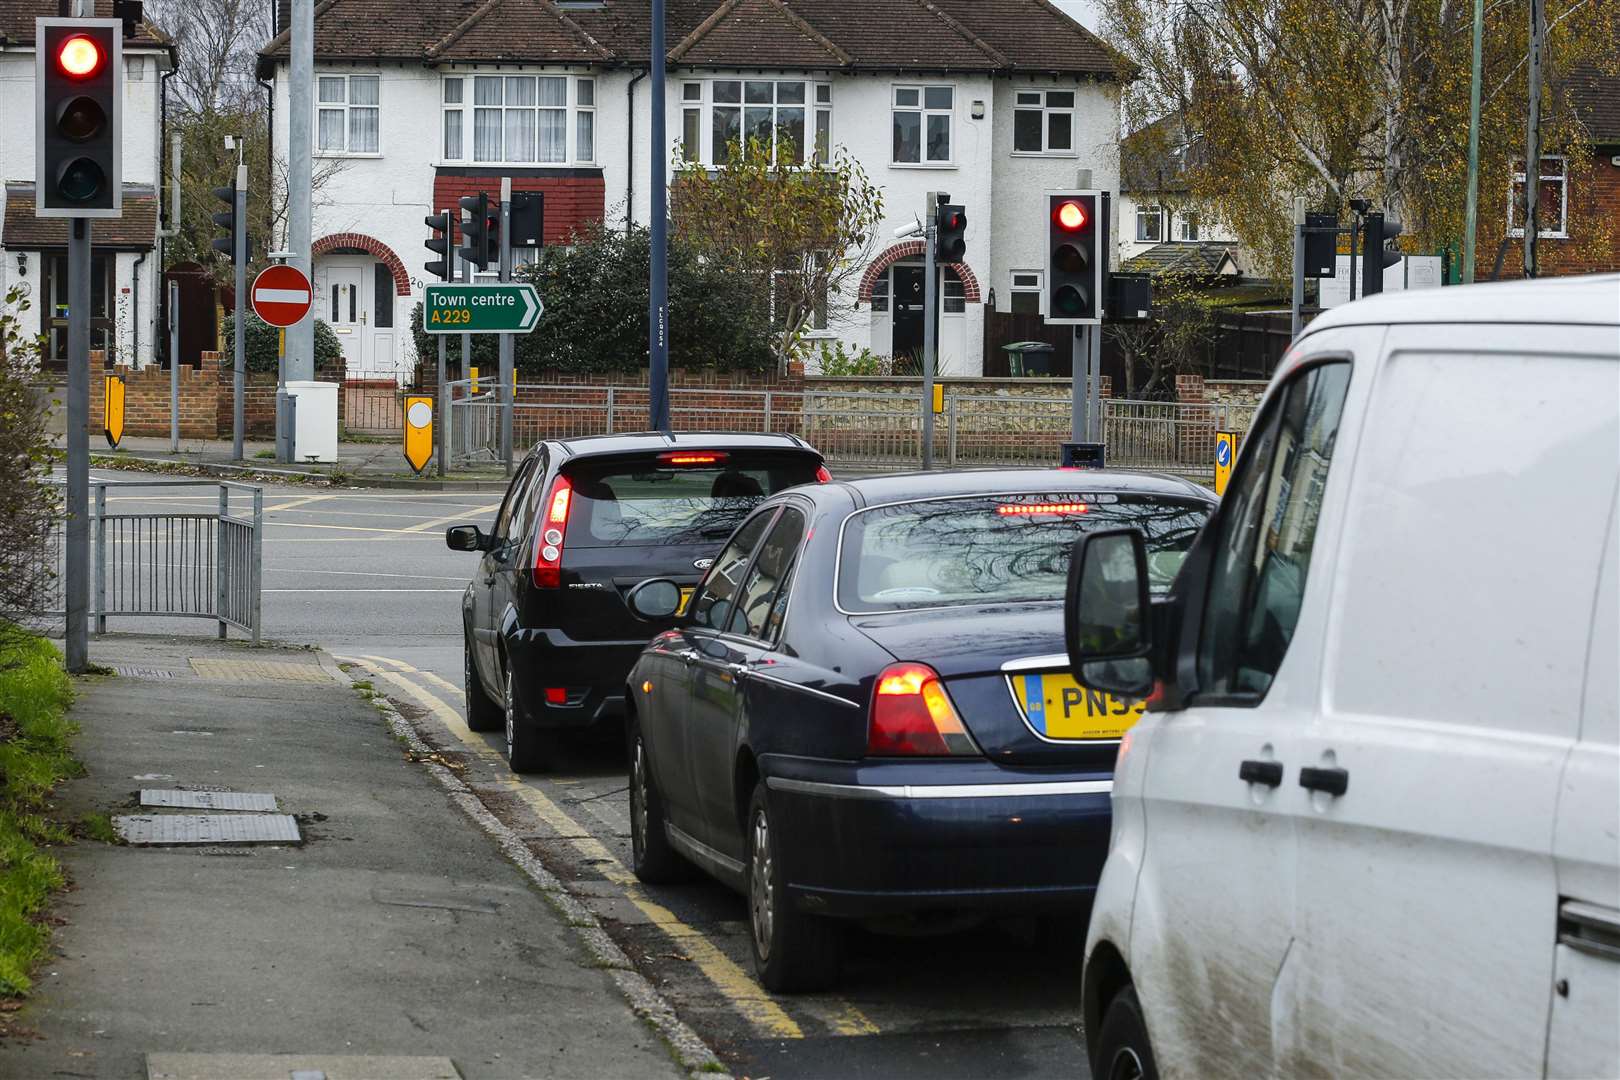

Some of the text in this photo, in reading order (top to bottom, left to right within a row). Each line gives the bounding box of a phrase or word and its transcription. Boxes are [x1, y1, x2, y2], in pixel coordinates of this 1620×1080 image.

[431, 292, 515, 306] Town centre
[431, 309, 471, 323] A229
[1062, 687, 1146, 718] PN5
